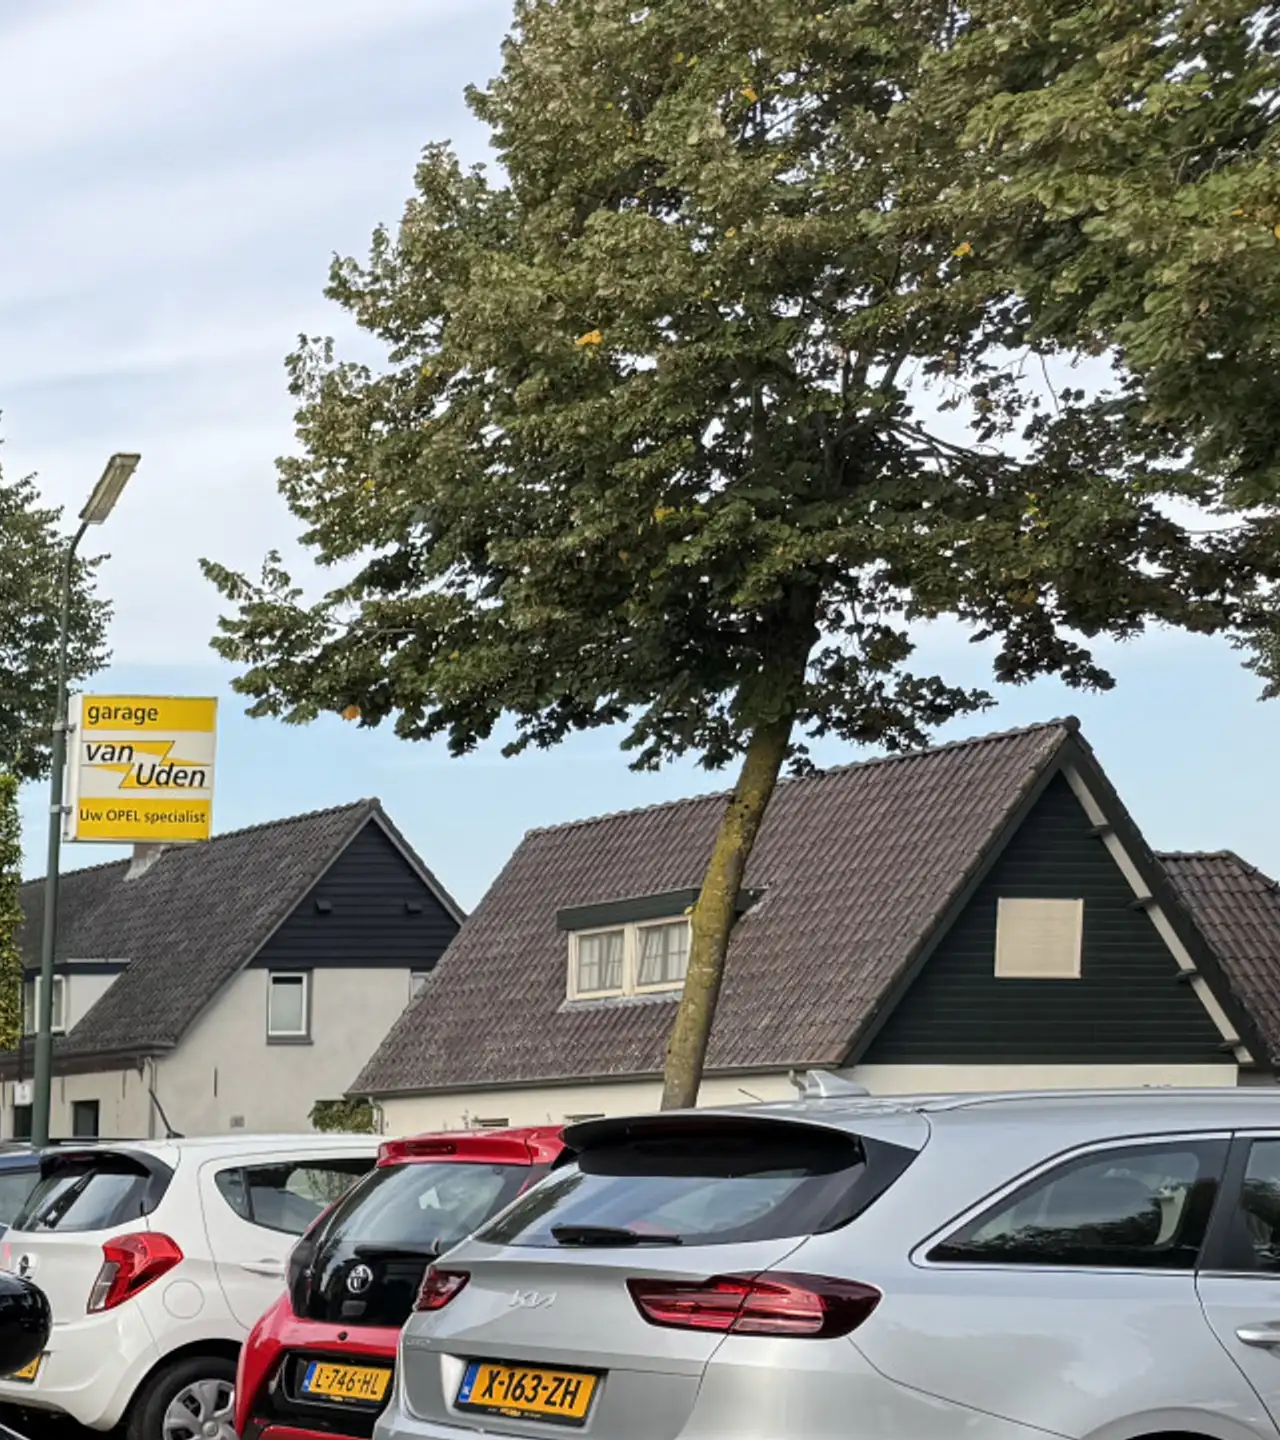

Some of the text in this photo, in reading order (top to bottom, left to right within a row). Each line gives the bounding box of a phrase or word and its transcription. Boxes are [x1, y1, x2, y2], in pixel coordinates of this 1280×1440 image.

[87, 705, 159, 725] garage
[86, 743, 134, 763] van
[136, 762, 206, 788] Uden
[80, 809, 206, 825] Uw OPEL specialist
[315, 1367, 380, 1395] L-746-HL
[481, 1369, 582, 1409] X-163-ZH
